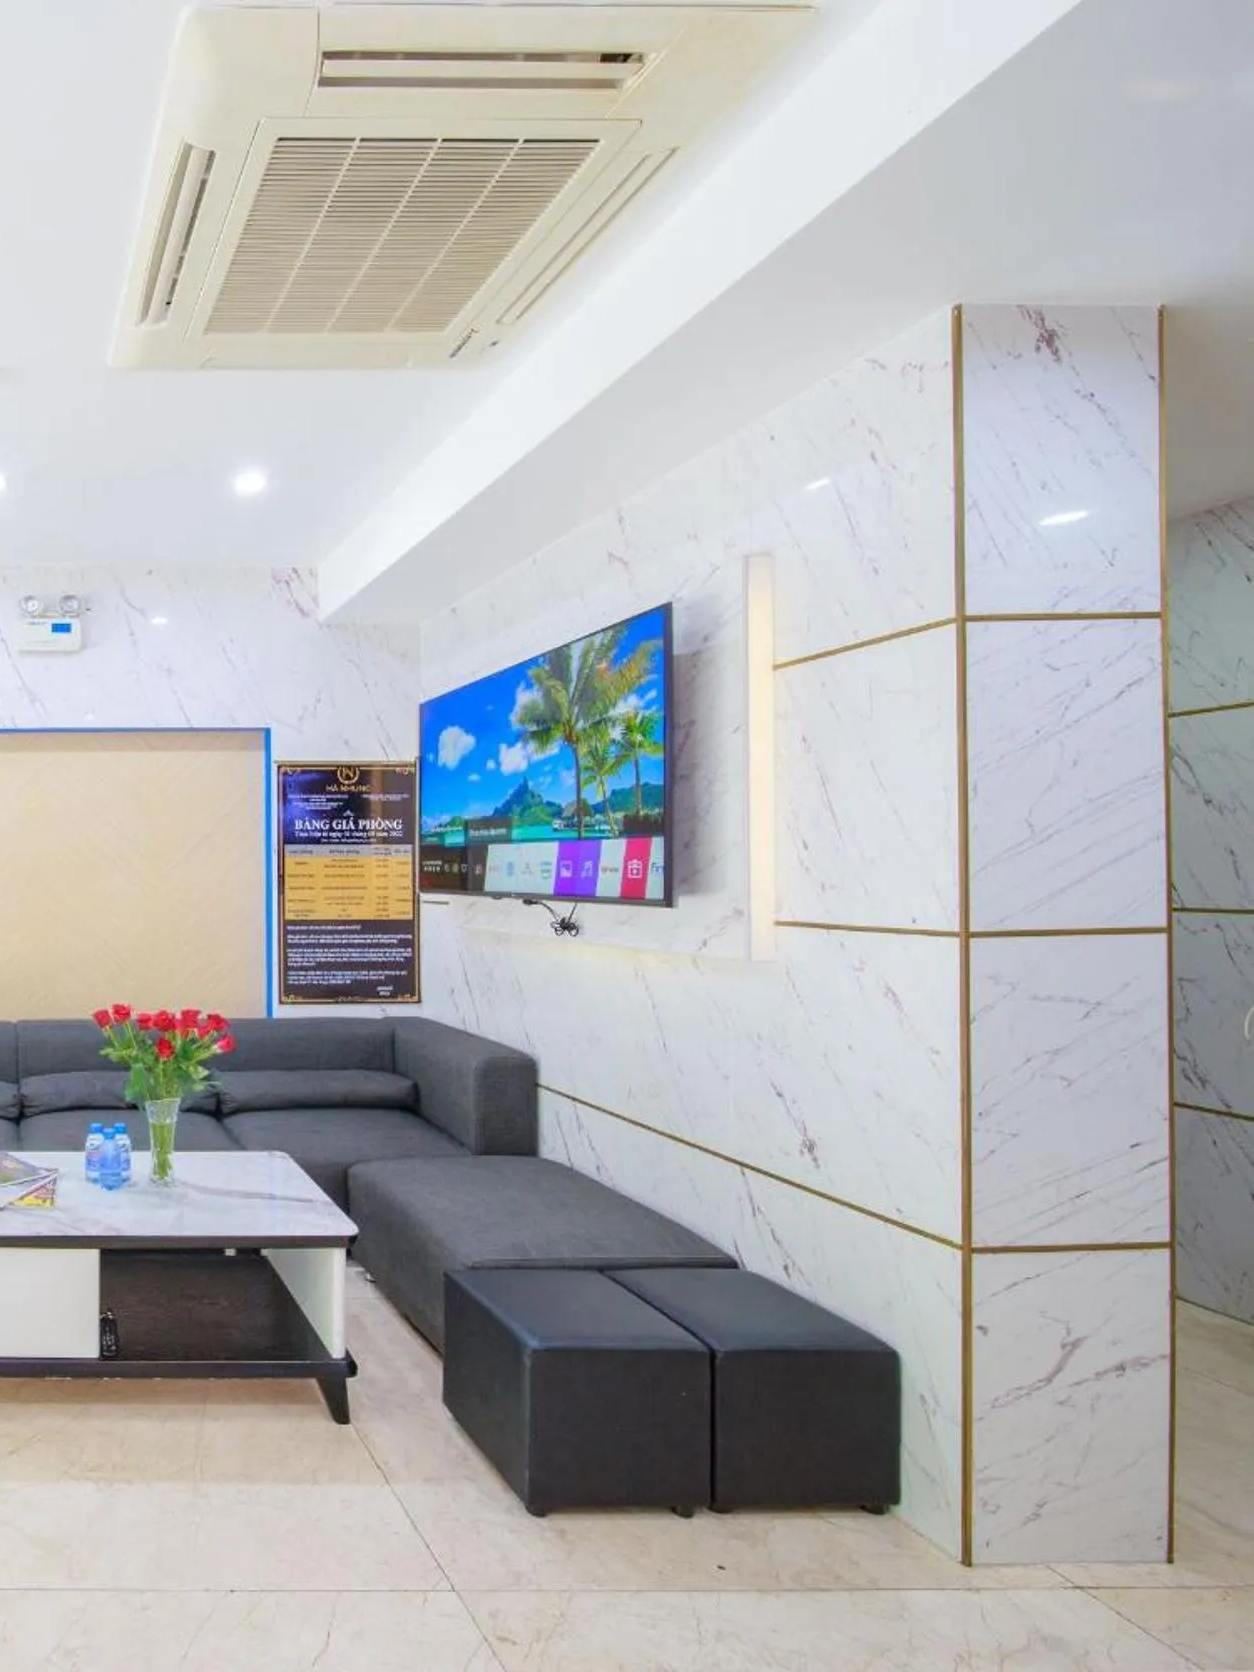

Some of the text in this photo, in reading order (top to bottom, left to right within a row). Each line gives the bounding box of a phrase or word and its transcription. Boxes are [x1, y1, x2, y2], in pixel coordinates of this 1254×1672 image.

[294, 817, 403, 830] BẢNG GIÁ PHÒNG
